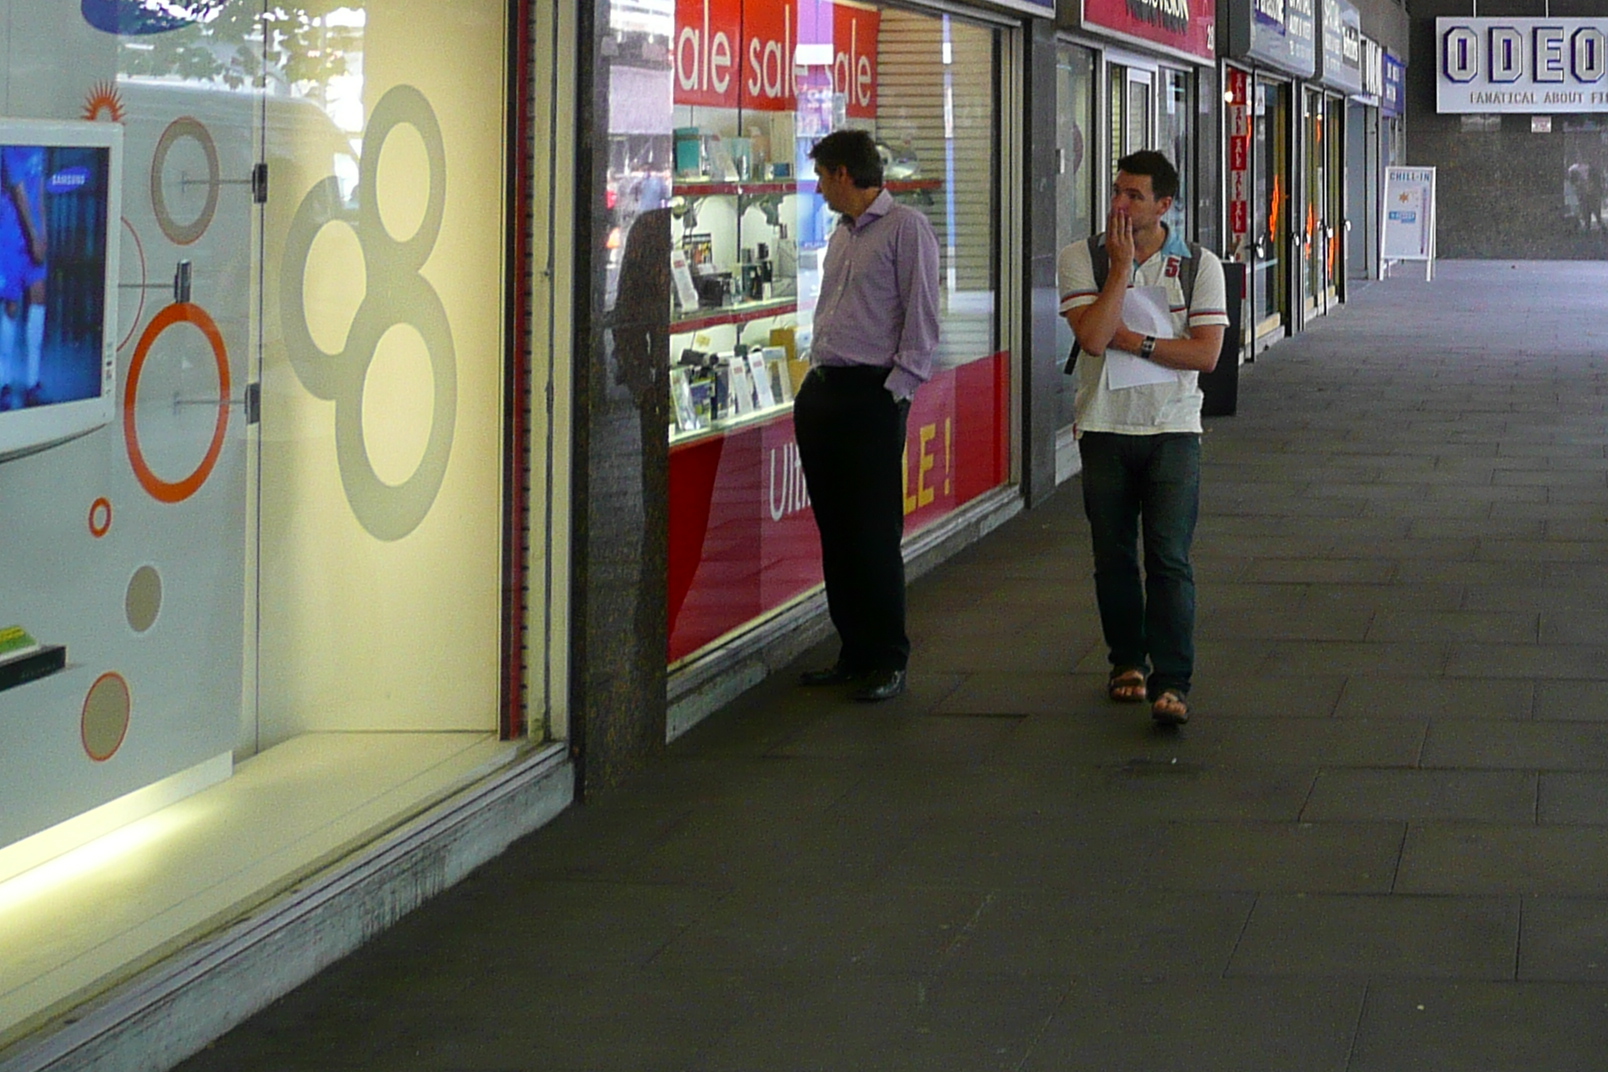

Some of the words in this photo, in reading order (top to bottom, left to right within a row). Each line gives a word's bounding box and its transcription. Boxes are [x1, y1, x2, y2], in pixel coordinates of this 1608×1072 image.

[1470, 91, 1537, 104] FANATICAL
[1544, 91, 1584, 104] ABOUT
[1389, 172, 1430, 182] CHILL-IN
